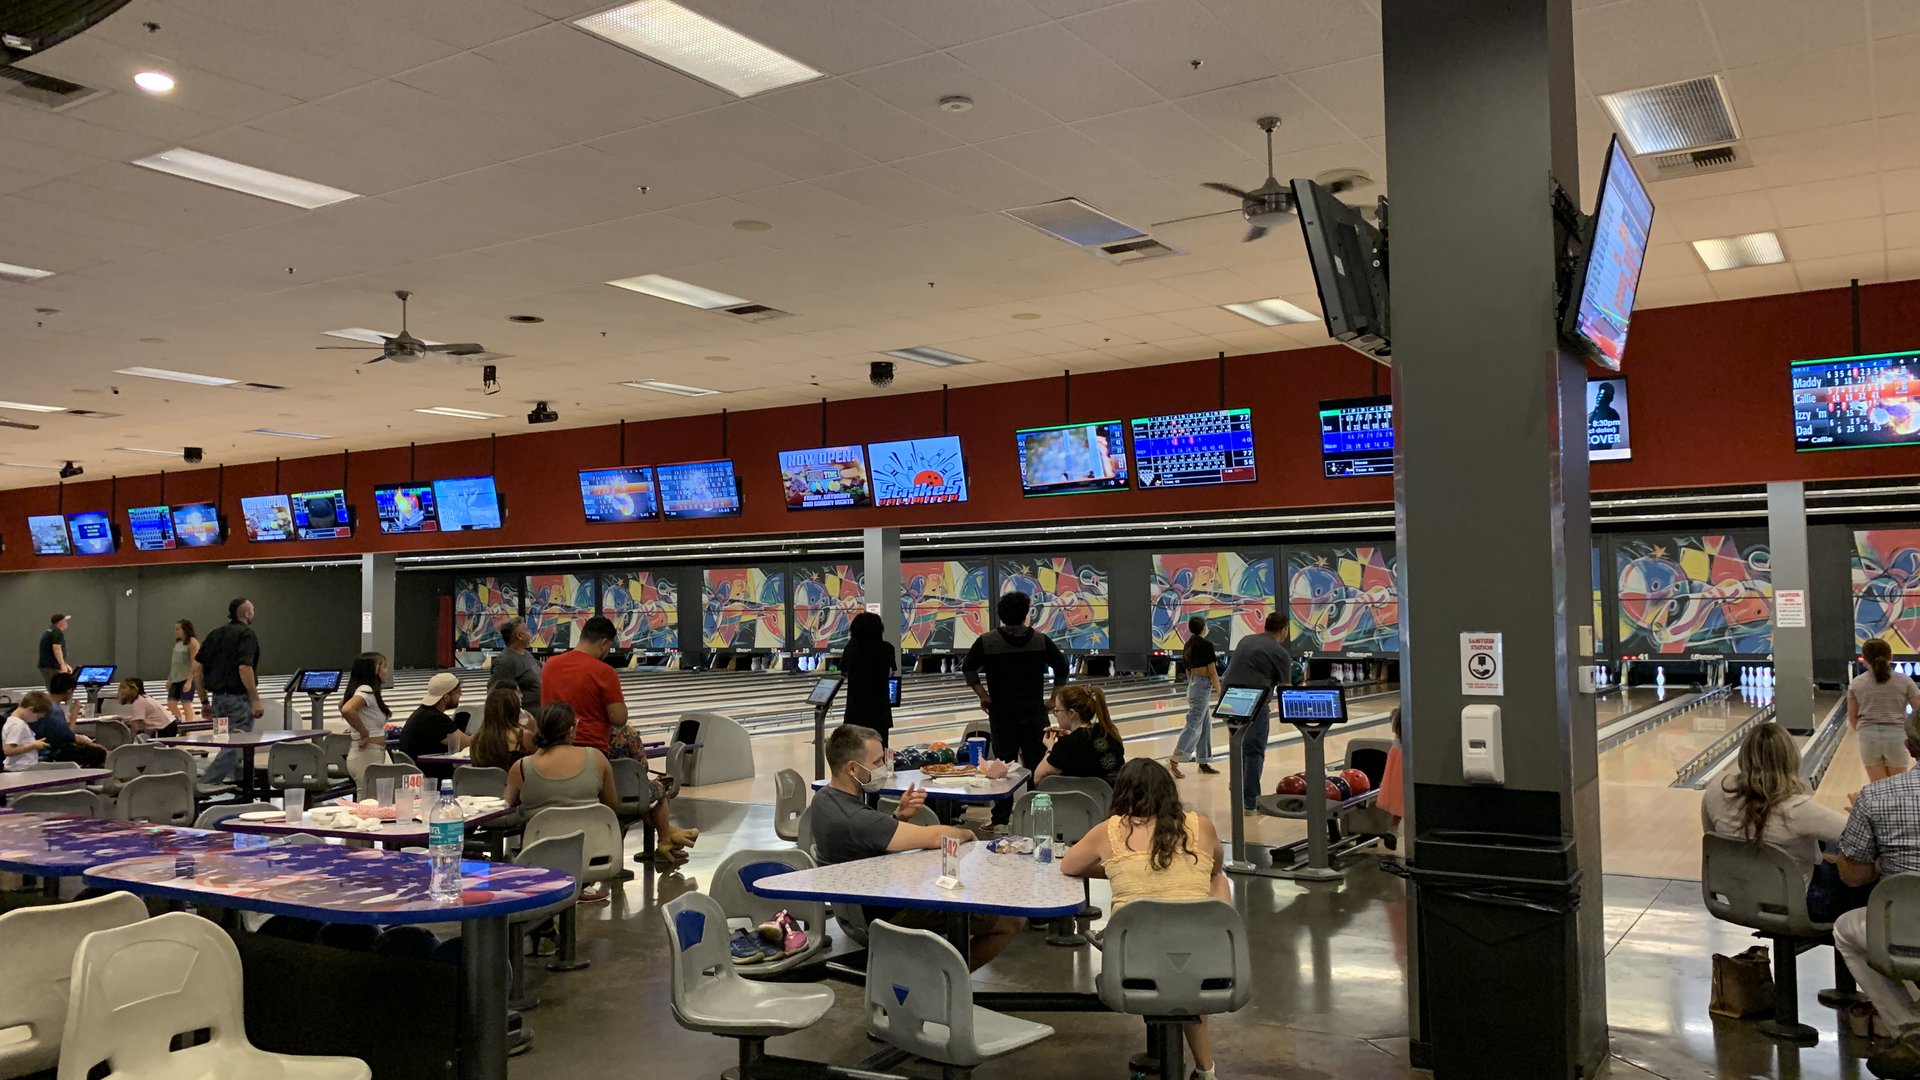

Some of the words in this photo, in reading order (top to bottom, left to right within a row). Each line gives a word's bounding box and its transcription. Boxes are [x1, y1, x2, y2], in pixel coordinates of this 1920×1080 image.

[1793, 376, 1822, 389] Maddy
[1794, 393, 1817, 403] Callie
[1795, 410, 1811, 421] Izzy
[1796, 425, 1813, 436] Dad
[787, 453, 815, 467] NOW
[818, 450, 855, 465] OPEN!
[409, 775, 422, 788] 40
[947, 839, 958, 858] 42
